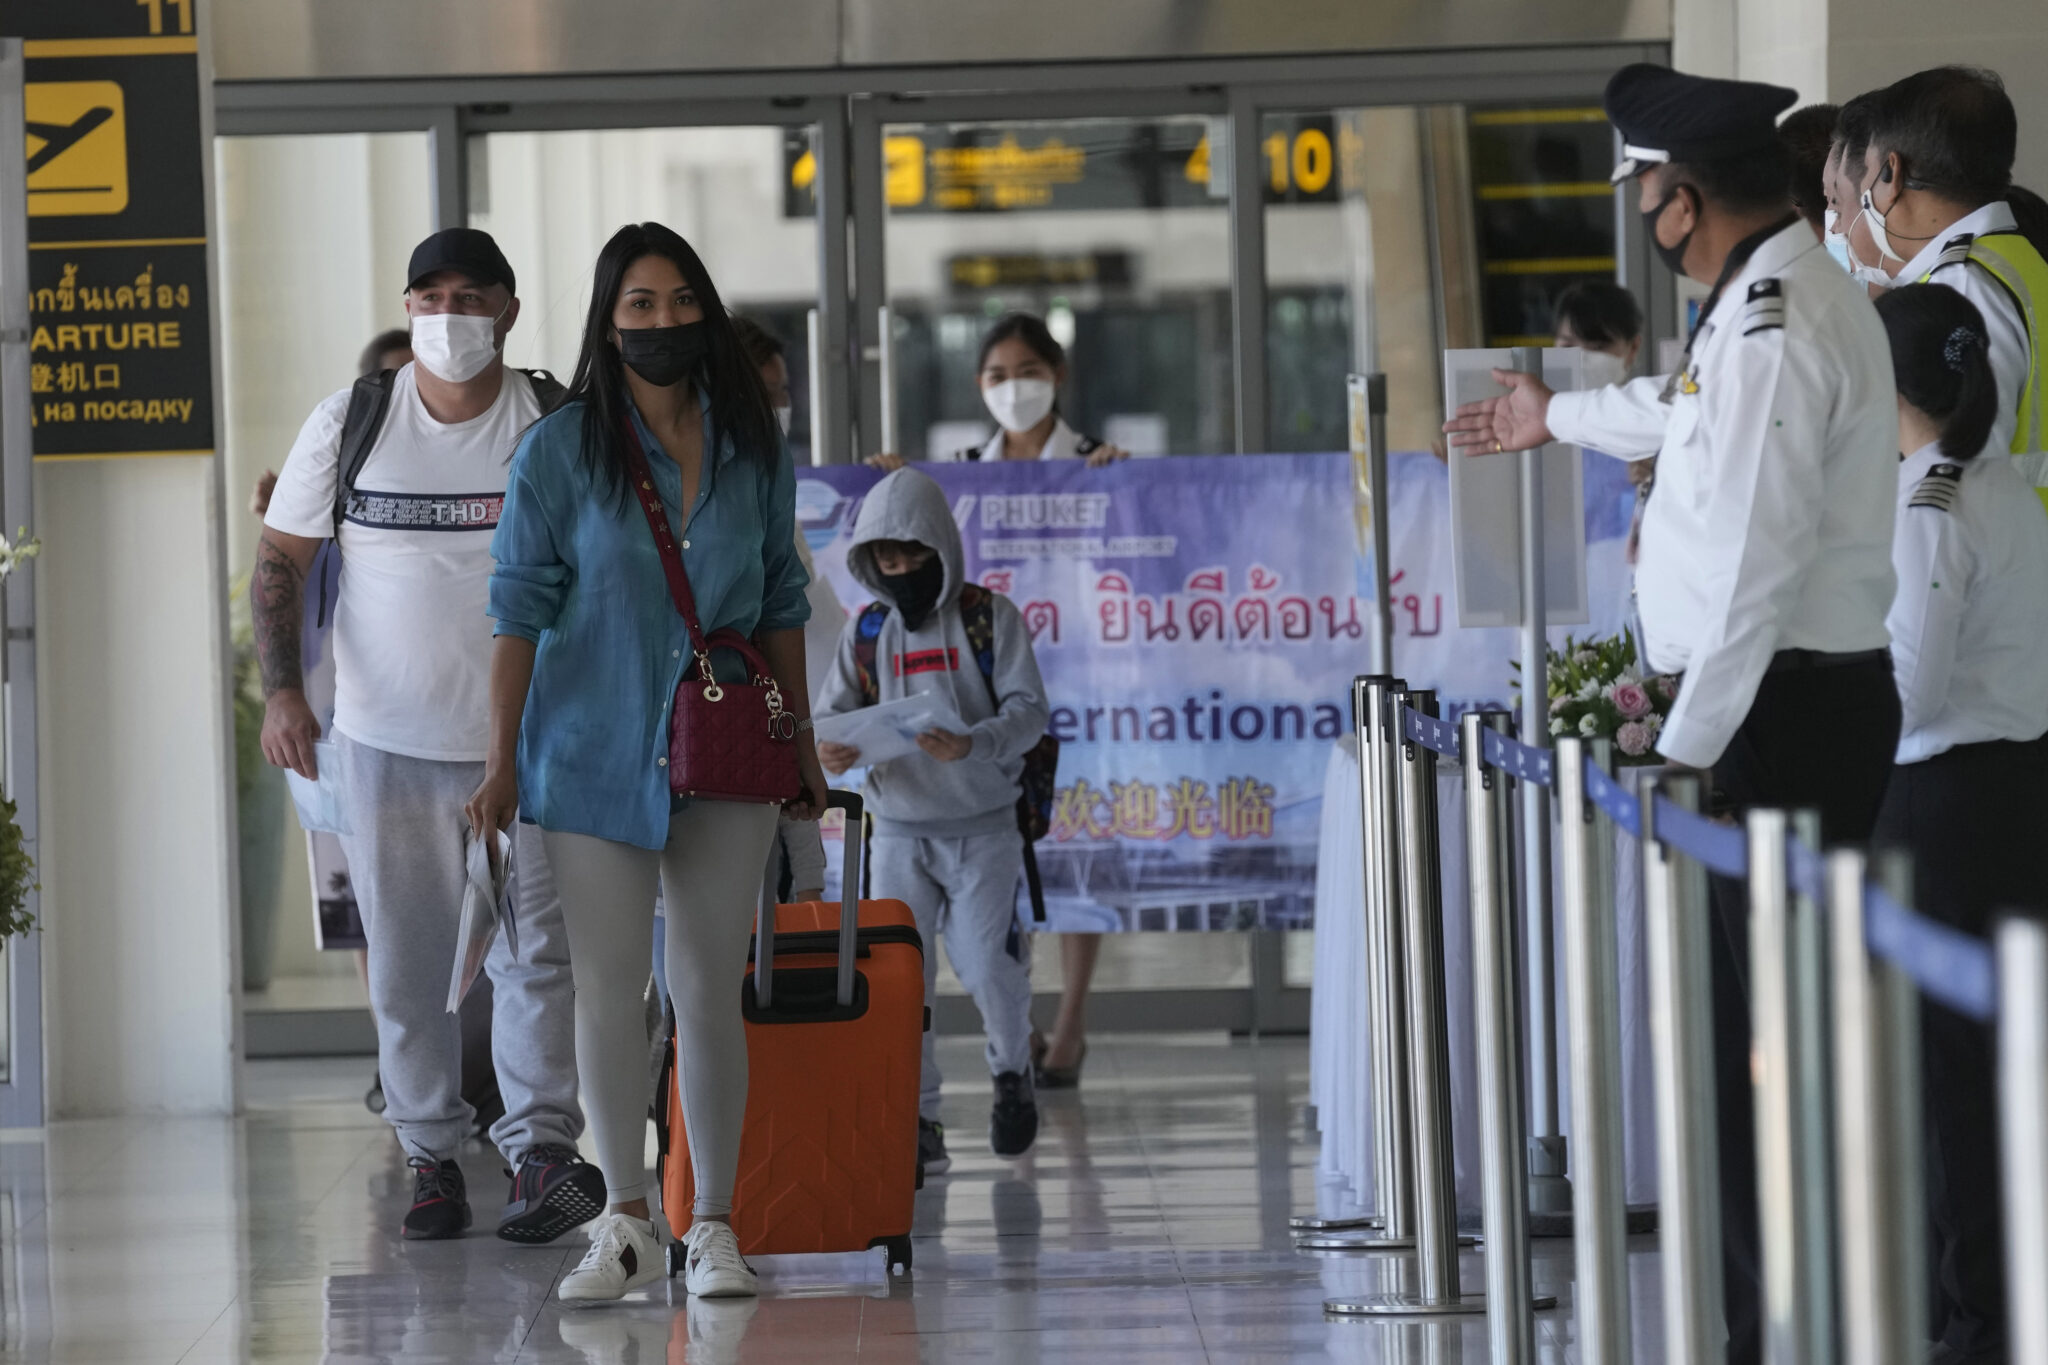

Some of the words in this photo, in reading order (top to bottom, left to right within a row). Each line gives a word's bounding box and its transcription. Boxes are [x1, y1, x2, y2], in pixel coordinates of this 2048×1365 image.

[136, 0, 193, 35] 11
[1262, 128, 1332, 194] 10
[29, 263, 190, 312] กขึ้นเครื่อง
[30, 322, 181, 352] ARTURE
[43, 401, 76, 422] на
[82, 398, 193, 424] посадку
[431, 503, 487, 522] THD
[982, 494, 1110, 529] PHUKET
[1096, 566, 1443, 642] ยินดีต้อนบ
[1051, 777, 1276, 841] 欢迎光临
